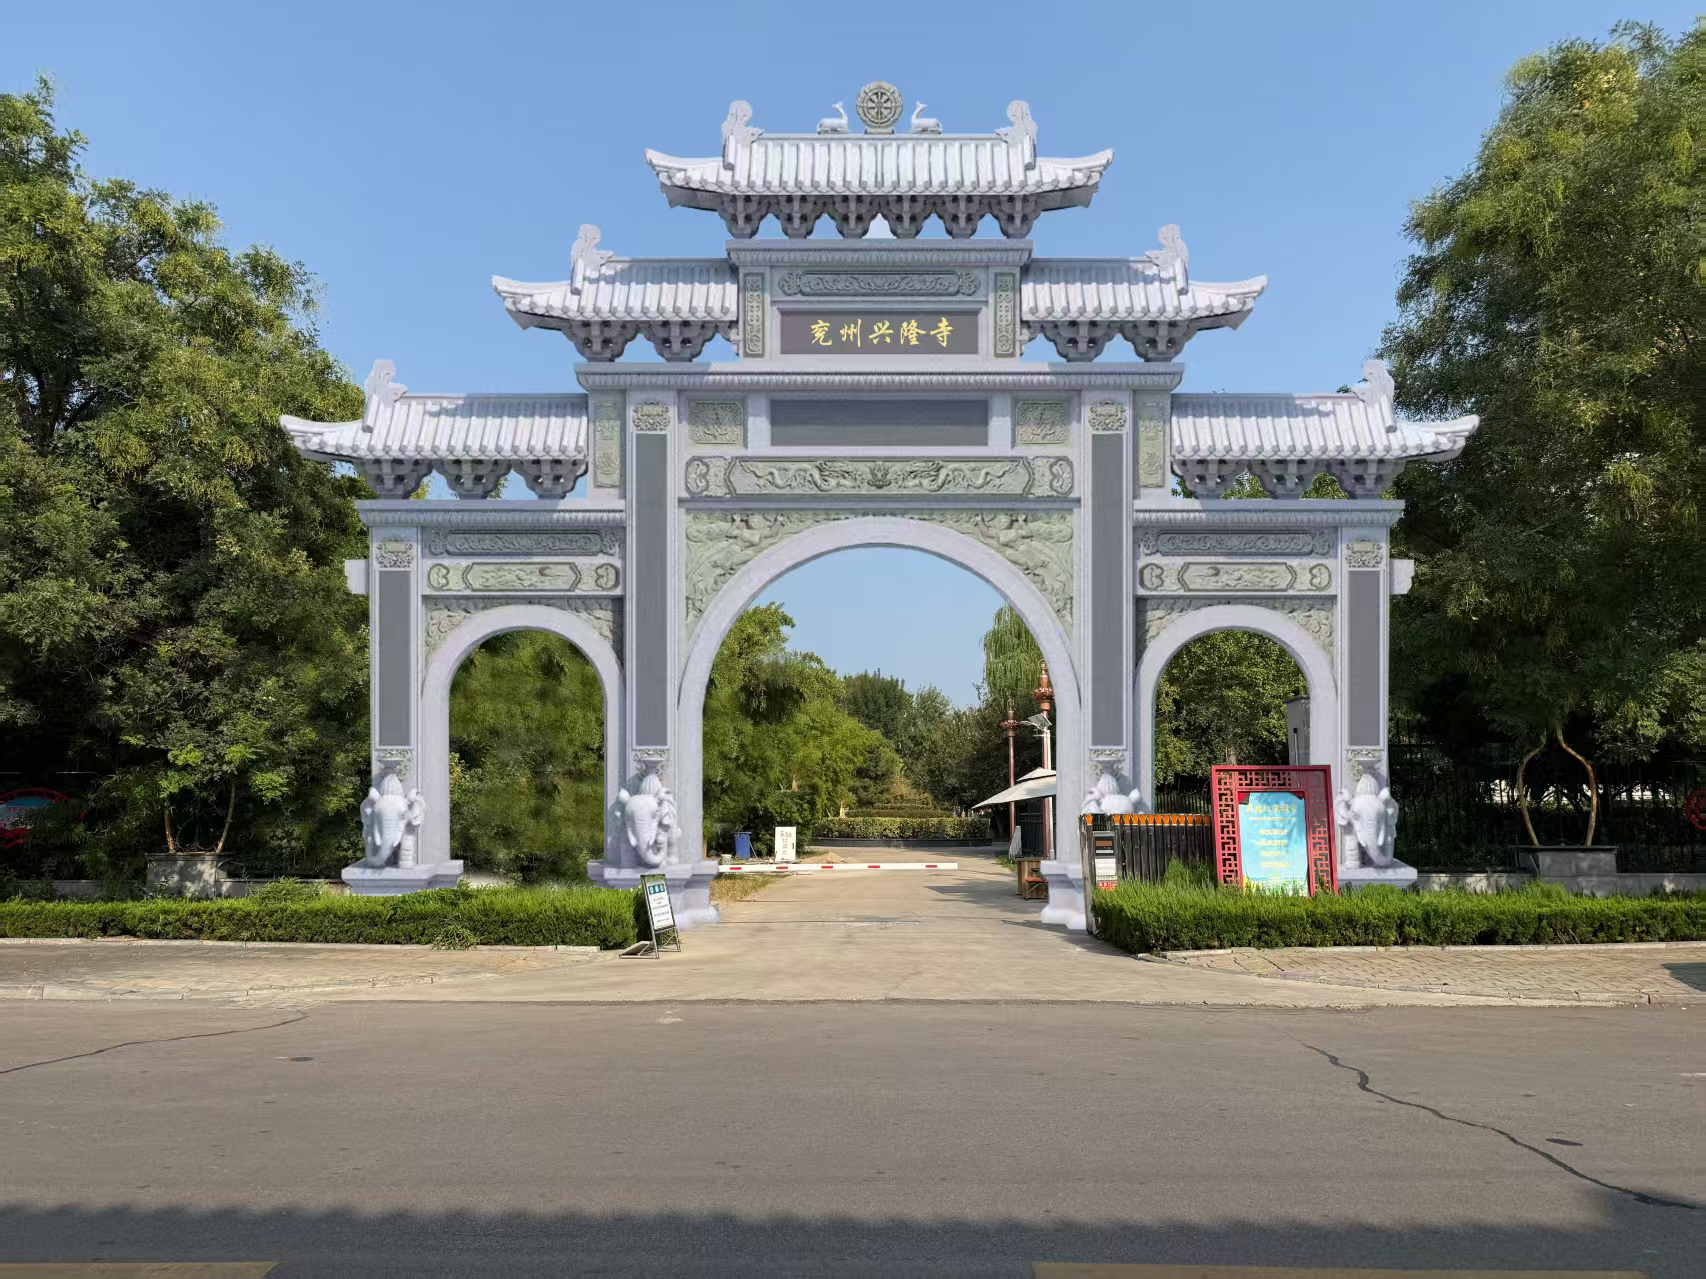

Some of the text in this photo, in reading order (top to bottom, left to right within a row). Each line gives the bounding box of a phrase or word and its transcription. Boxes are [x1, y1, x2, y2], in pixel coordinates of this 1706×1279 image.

[809, 317, 954, 347] 兖州兴隆寺
